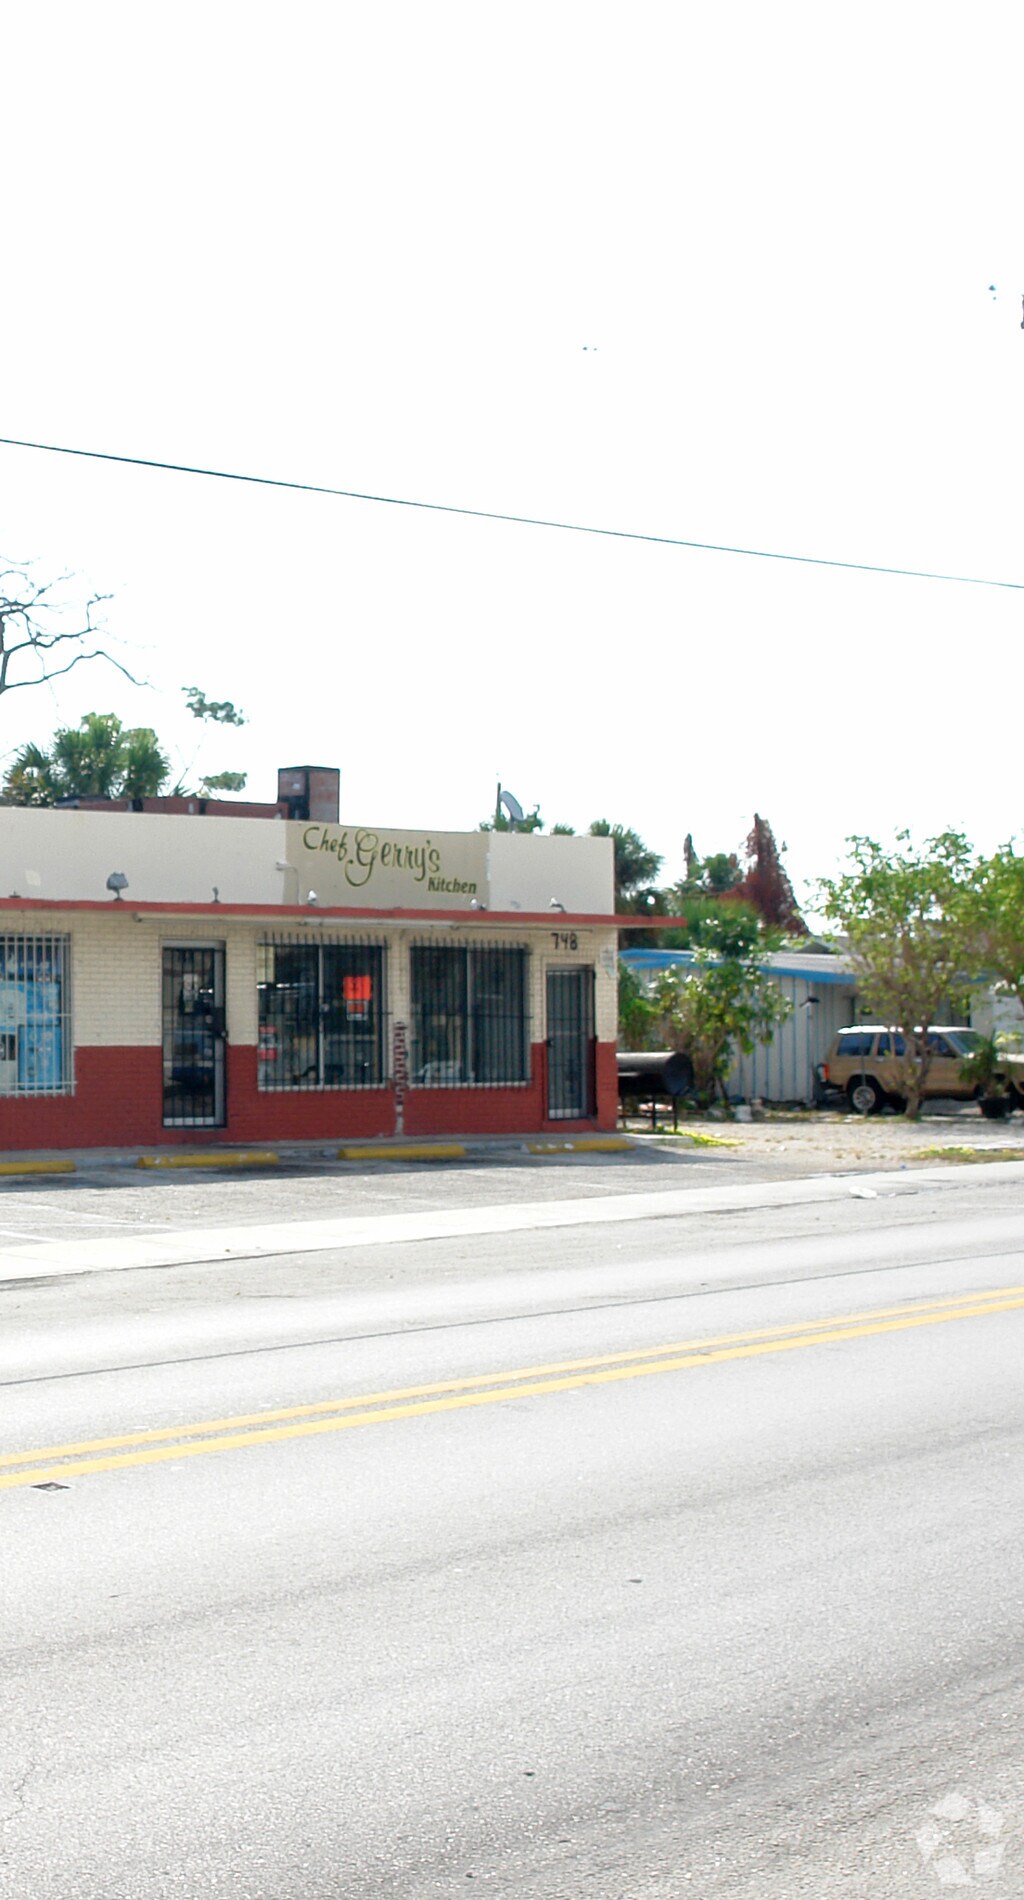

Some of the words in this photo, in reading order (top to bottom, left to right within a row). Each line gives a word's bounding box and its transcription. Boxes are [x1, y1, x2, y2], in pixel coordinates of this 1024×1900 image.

[302, 826, 349, 862] Chef
[344, 828, 441, 888] Gerry's
[427, 876, 477, 895] Kitchen
[551, 932, 578, 951] 748
